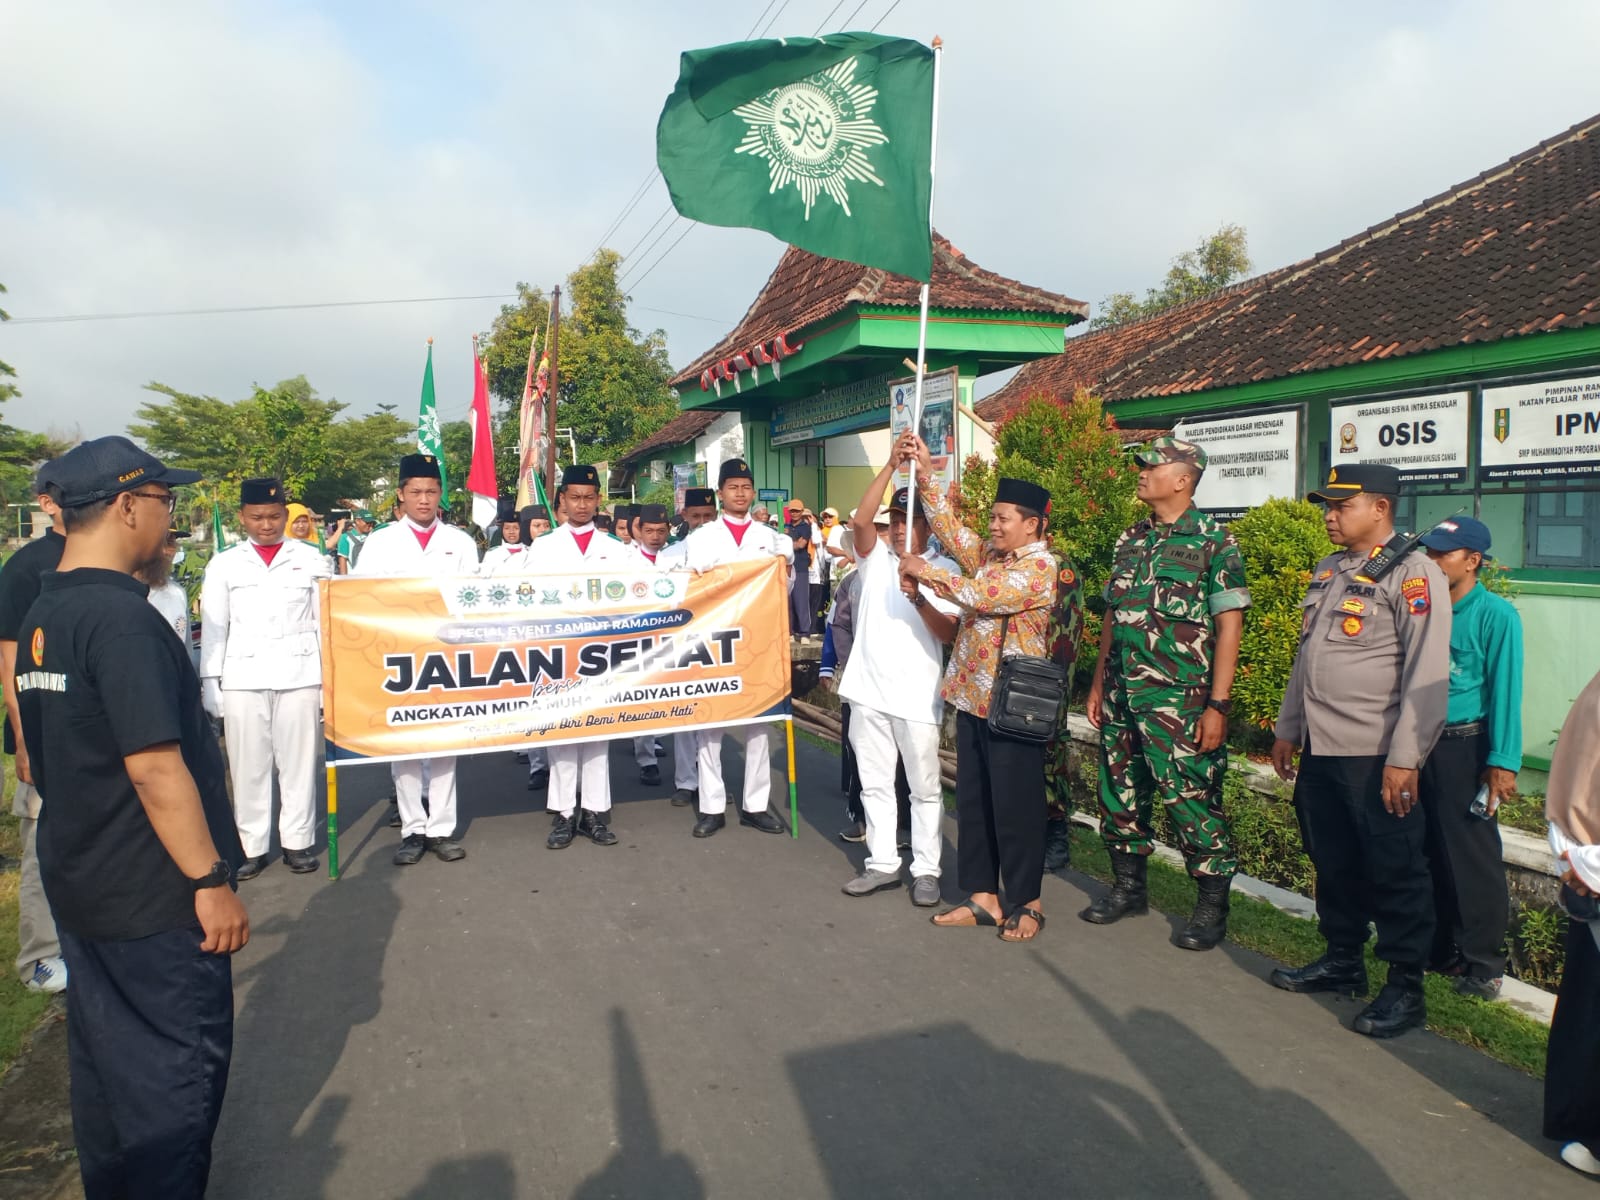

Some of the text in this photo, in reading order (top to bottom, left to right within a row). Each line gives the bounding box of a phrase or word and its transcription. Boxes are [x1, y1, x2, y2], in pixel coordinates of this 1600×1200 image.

[1545, 385, 1583, 396] PIMPINAN
[1357, 399, 1458, 417] ORGANISASI SISWA INTRA SEKOLAH
[1519, 397, 1544, 407] IKATAN
[1545, 395, 1578, 404] PELAJAR
[1185, 419, 1284, 437] MAJELIS PENDIDIKAN DASAR MENENGAH
[1556, 411, 1600, 436] IPM
[1379, 420, 1437, 447] OSIS
[1208, 449, 1289, 466] MUHAMMADIYAH PROGRAM KHUSUS CAWAS
[1402, 454, 1423, 463] PROGRAM
[1442, 452, 1457, 461] CAWAS
[1519, 448, 1530, 458] SMP
[1345, 584, 1377, 597] POLRI
[449, 613, 683, 639] SPECIAL EVENT SAMBUT RAMADHAN
[385, 629, 740, 693] JALAN SEHAT
[391, 704, 487, 724] ANGKATAN
[492, 699, 541, 715] MUDA
[684, 679, 739, 697] CAWAS
[560, 715, 582, 730] Diri
[585, 712, 615, 727] Demi
[617, 707, 668, 724] Kesucian
